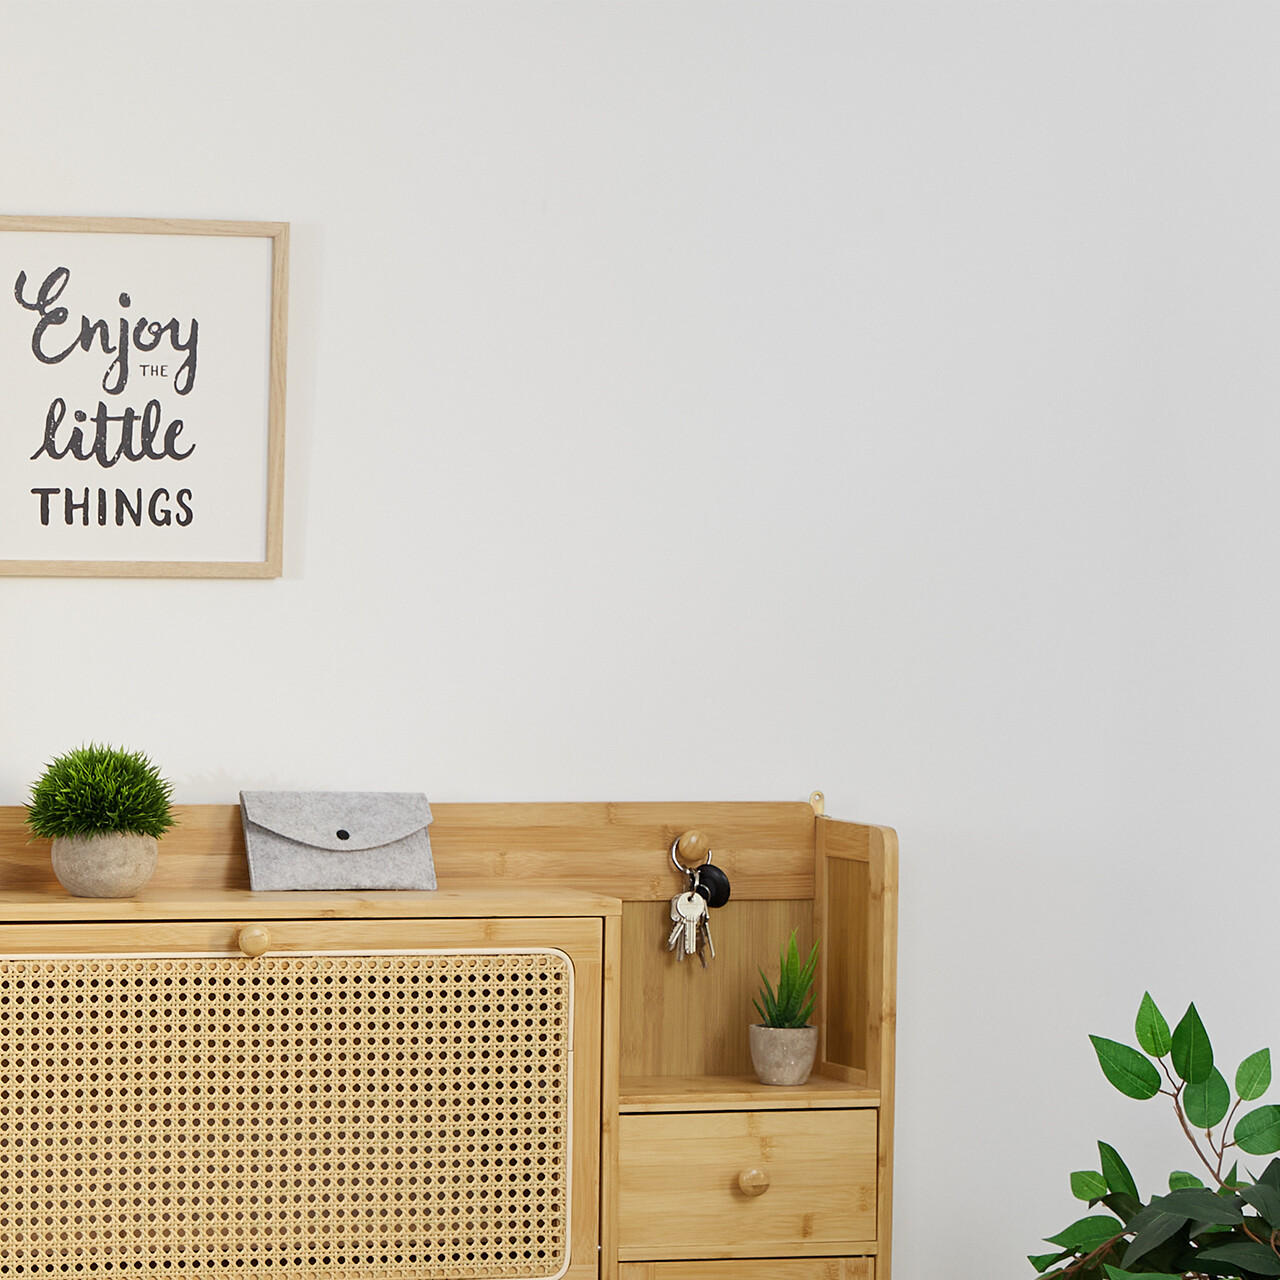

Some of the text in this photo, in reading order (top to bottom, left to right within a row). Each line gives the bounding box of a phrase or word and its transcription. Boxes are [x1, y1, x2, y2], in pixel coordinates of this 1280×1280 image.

[14, 266, 199, 395] Enjoy
[139, 364, 169, 378] THE
[30, 397, 196, 468] little
[30, 487, 193, 526] THINGS
